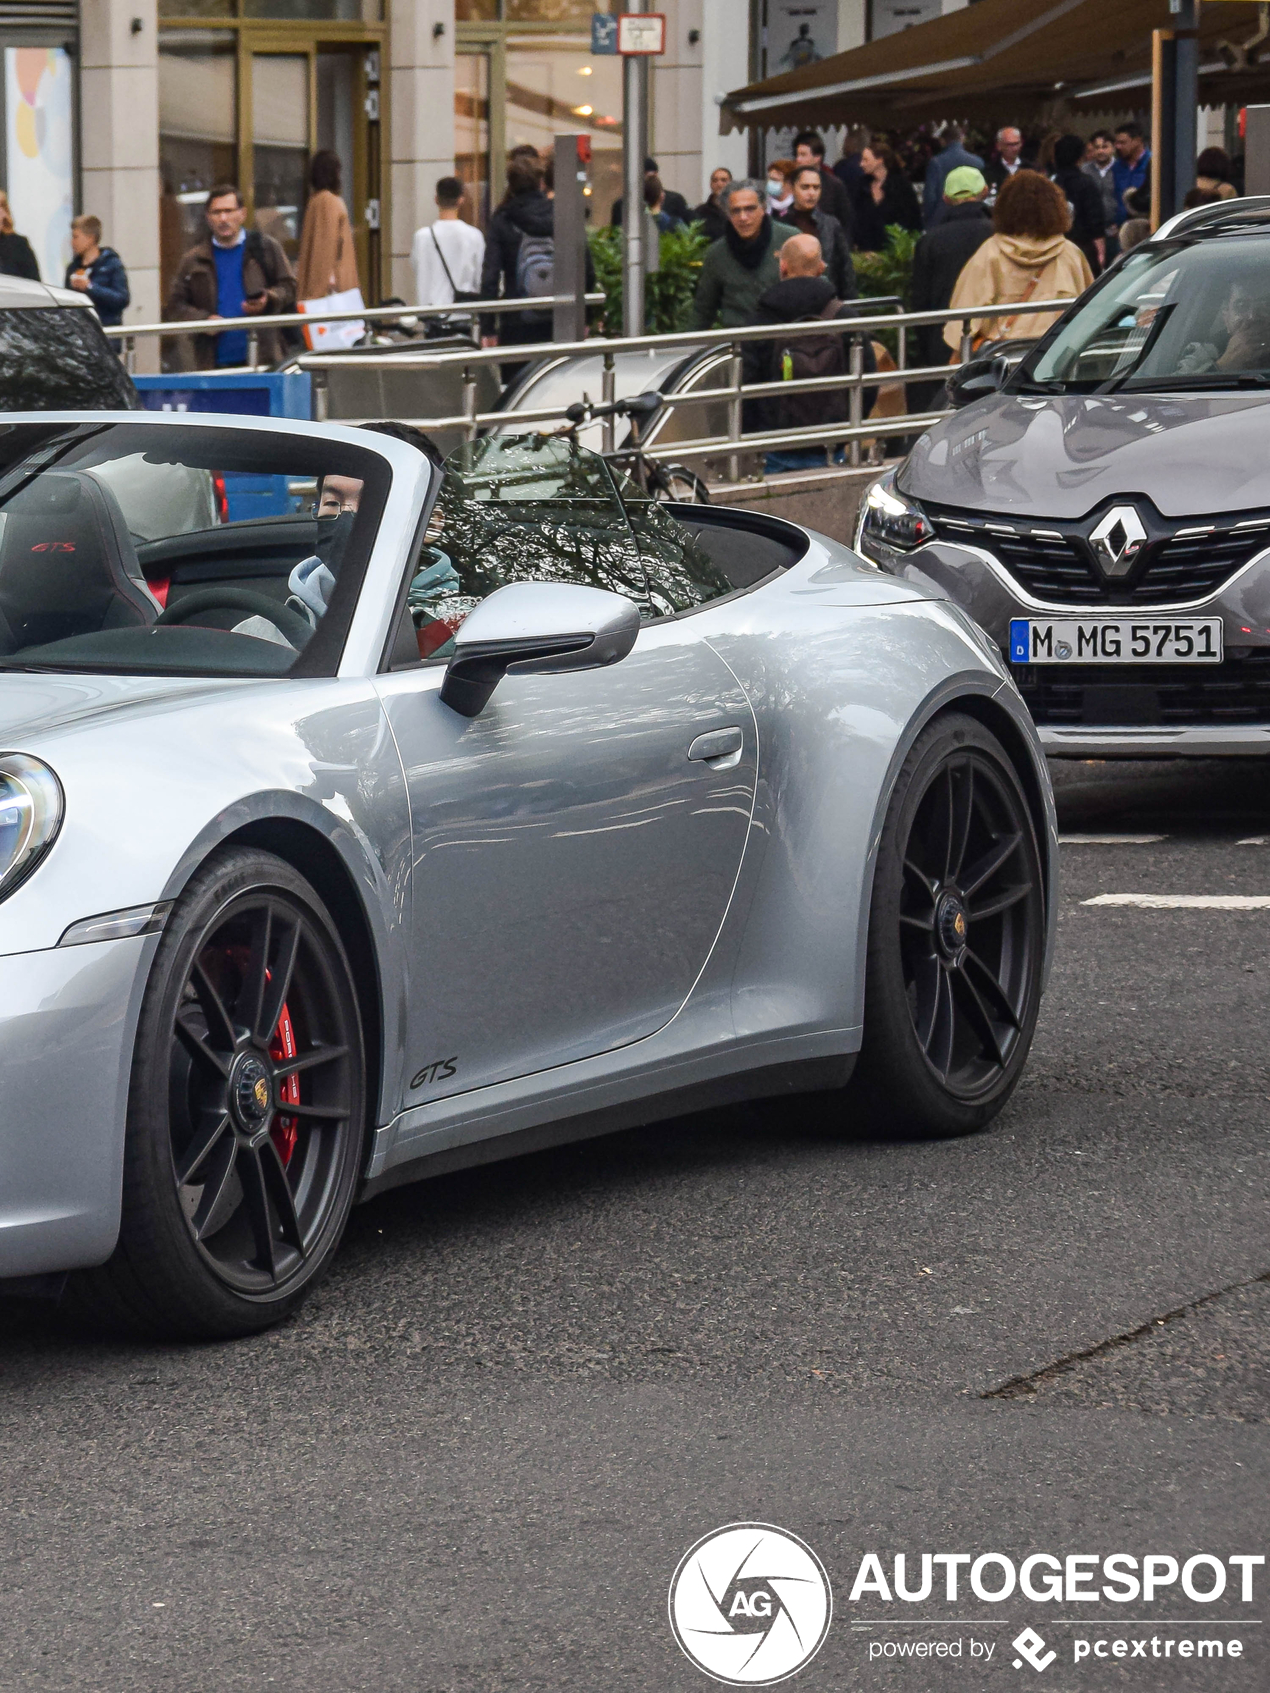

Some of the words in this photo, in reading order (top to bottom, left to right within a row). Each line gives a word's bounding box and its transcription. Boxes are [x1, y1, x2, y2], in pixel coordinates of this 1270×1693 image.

[31, 542, 76, 553] GTS
[1016, 645, 1025, 656] D
[1032, 625, 1054, 657] M
[1077, 625, 1122, 657] MG
[1131, 625, 1218, 657] 5751
[284, 1019, 298, 1099] PORHE
[409, 1056, 458, 1089] GTS
